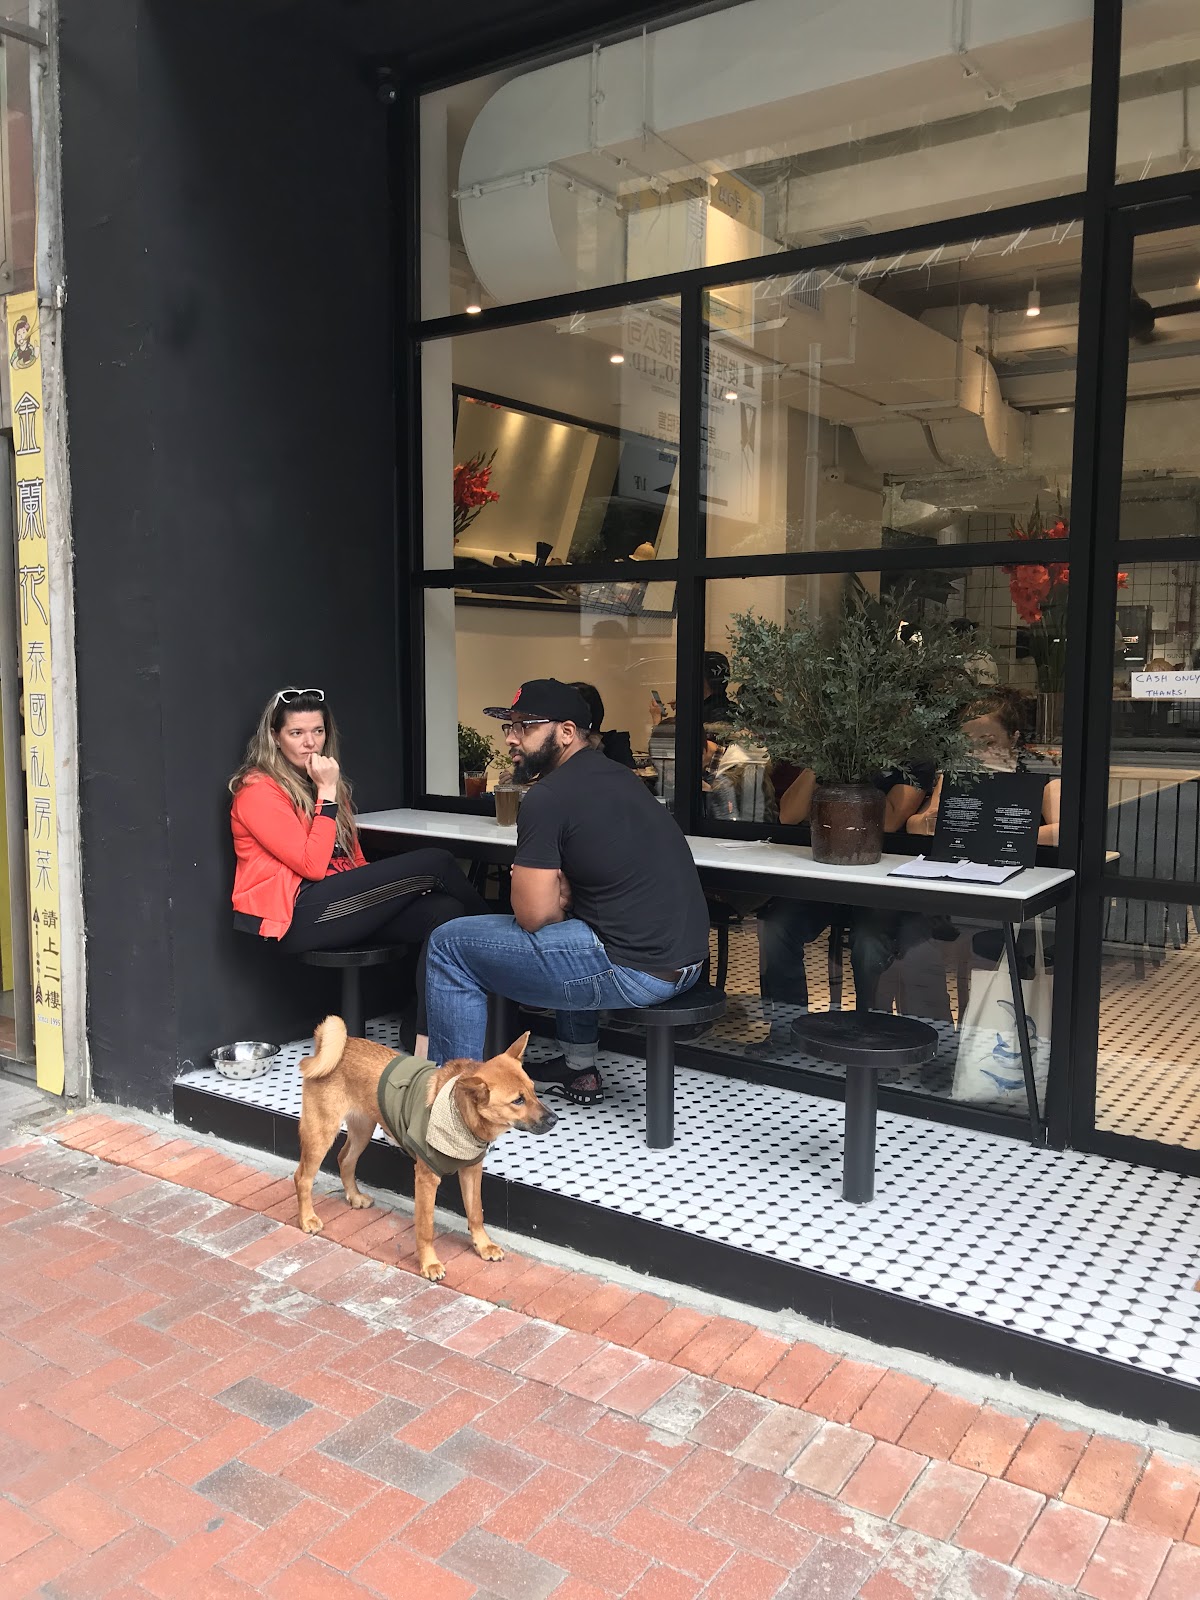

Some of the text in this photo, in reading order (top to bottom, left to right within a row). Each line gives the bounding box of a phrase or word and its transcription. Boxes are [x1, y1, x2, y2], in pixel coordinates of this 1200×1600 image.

[1135, 674, 1200, 684] CASH ONLY
[1145, 689, 1187, 697] THANKS!
[41, 908, 62, 1010] 請上二樓
[50, 1017, 61, 1027] 1995
